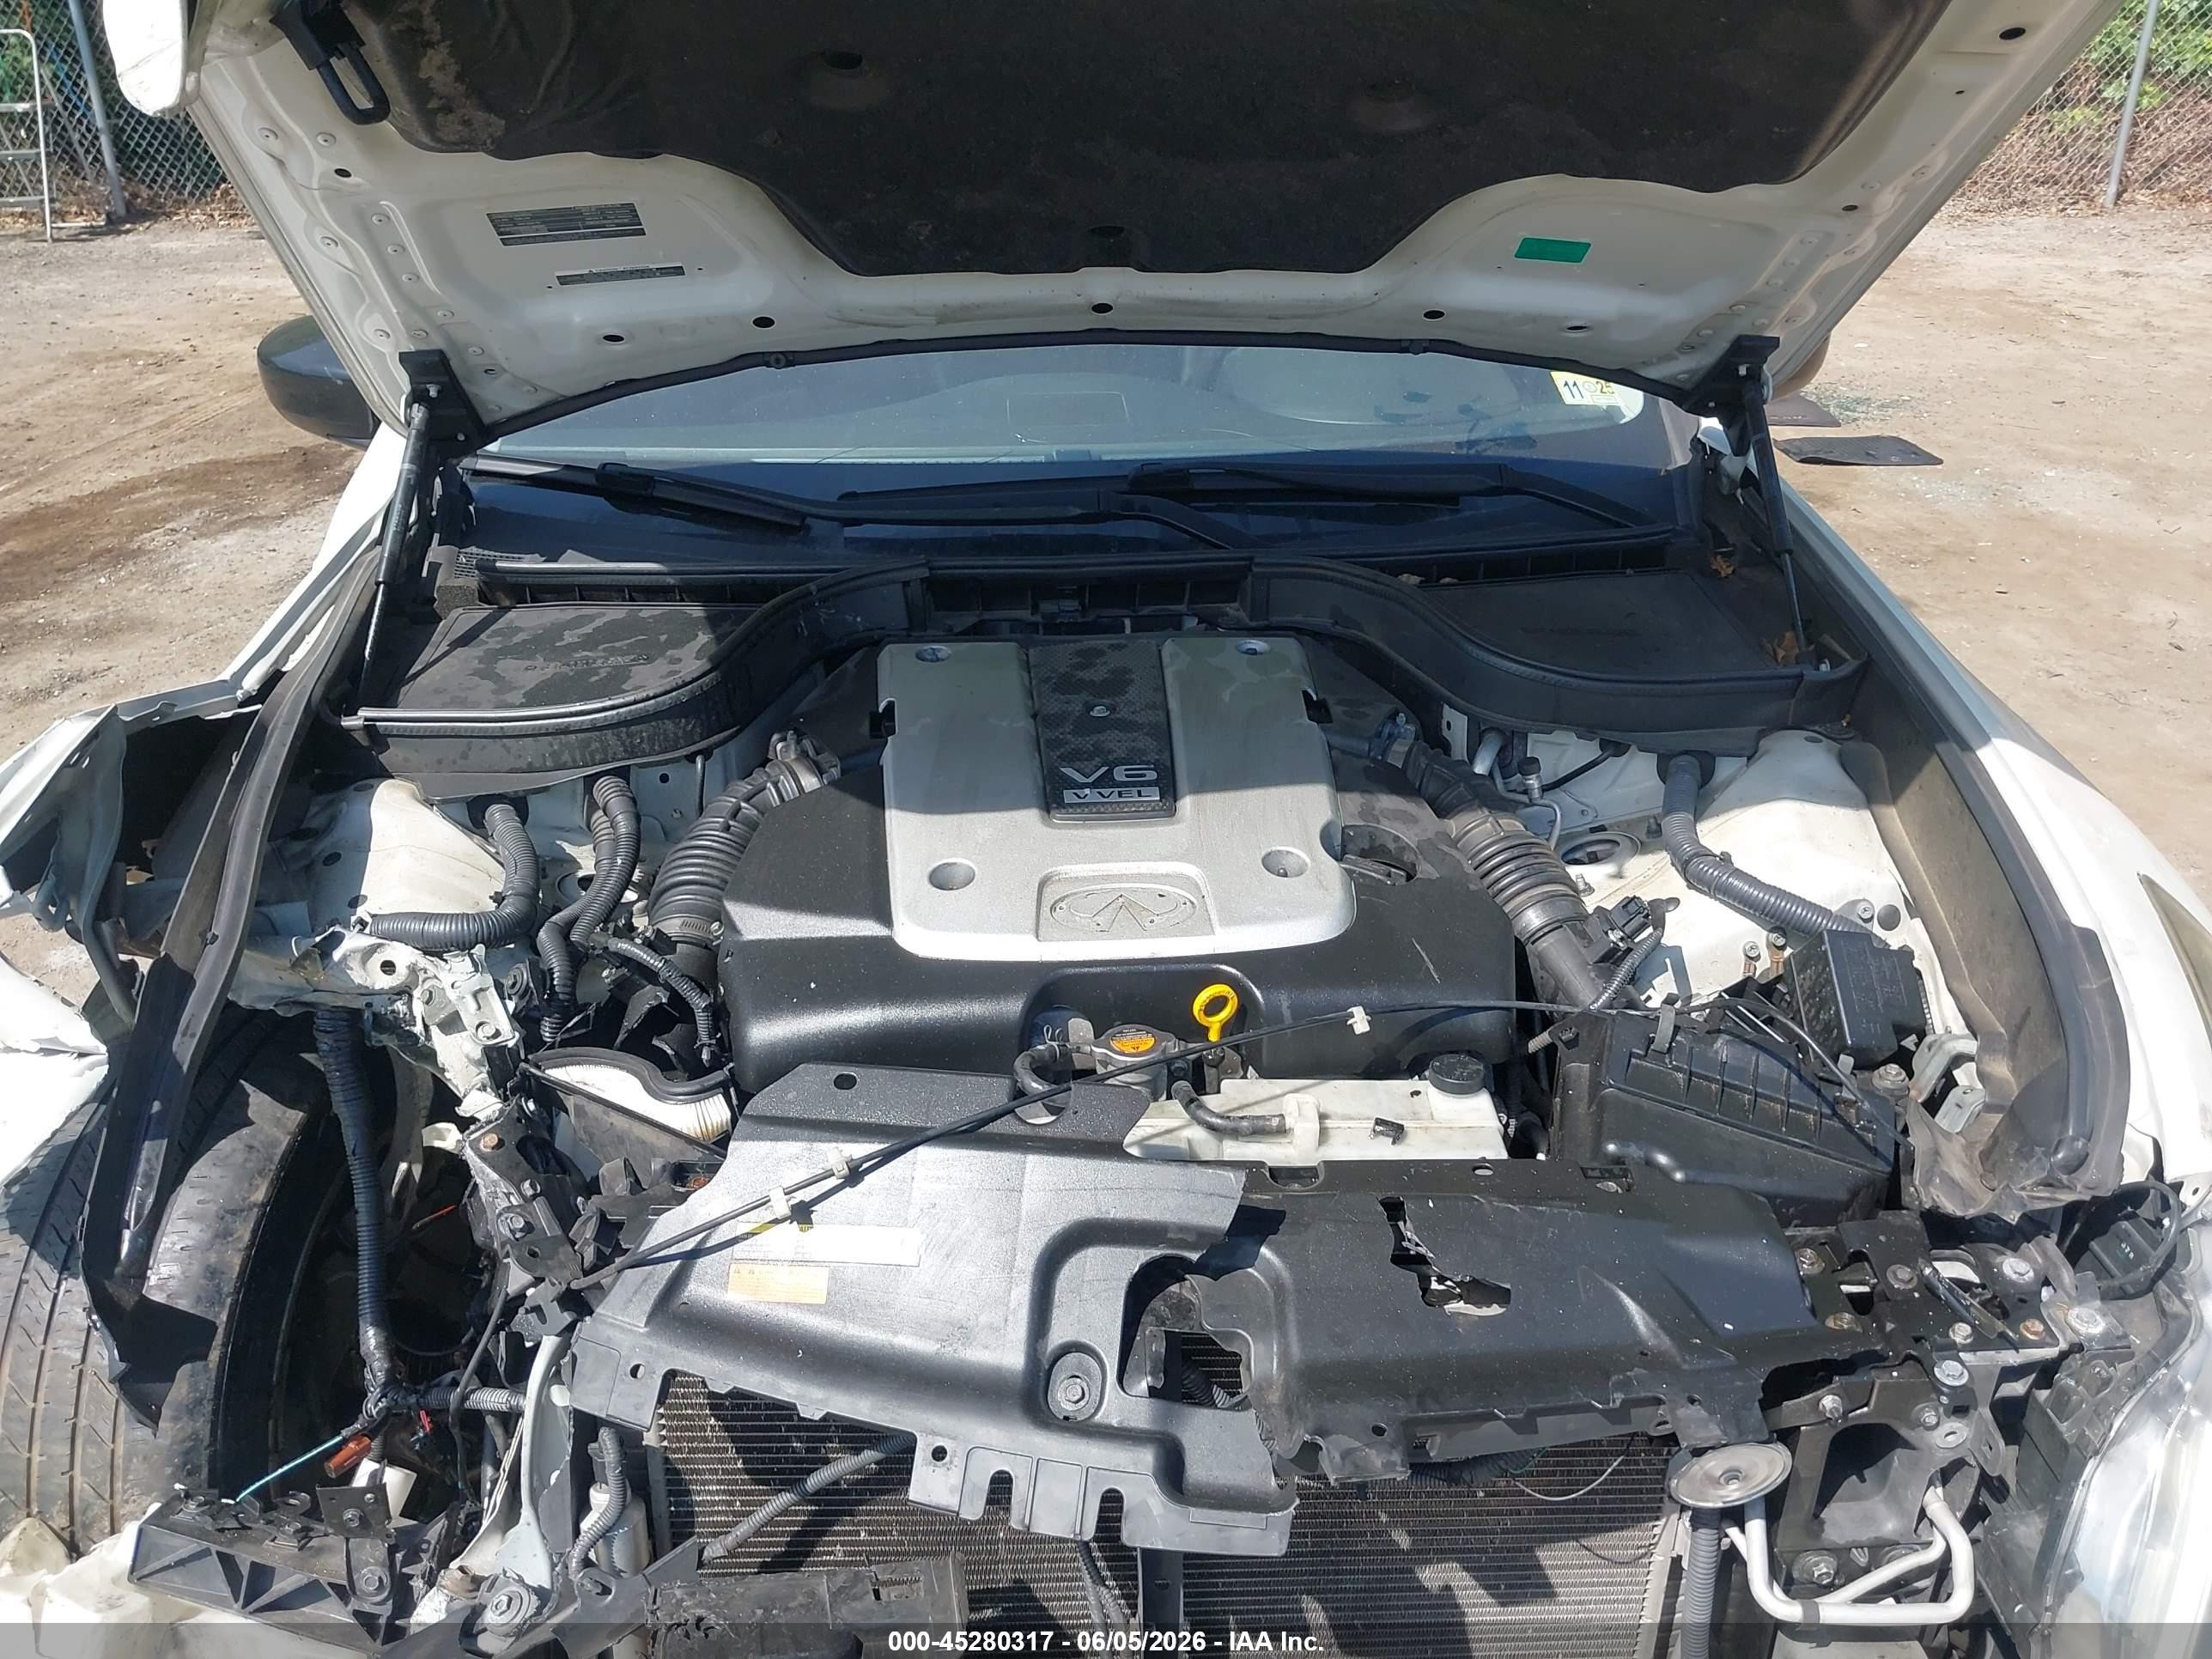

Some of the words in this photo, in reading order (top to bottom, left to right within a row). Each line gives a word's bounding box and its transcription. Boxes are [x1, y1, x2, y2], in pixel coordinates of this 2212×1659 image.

[1564, 380, 1583, 398] 11
[1595, 380, 1614, 394] 25
[1059, 763, 1158, 783] V6
